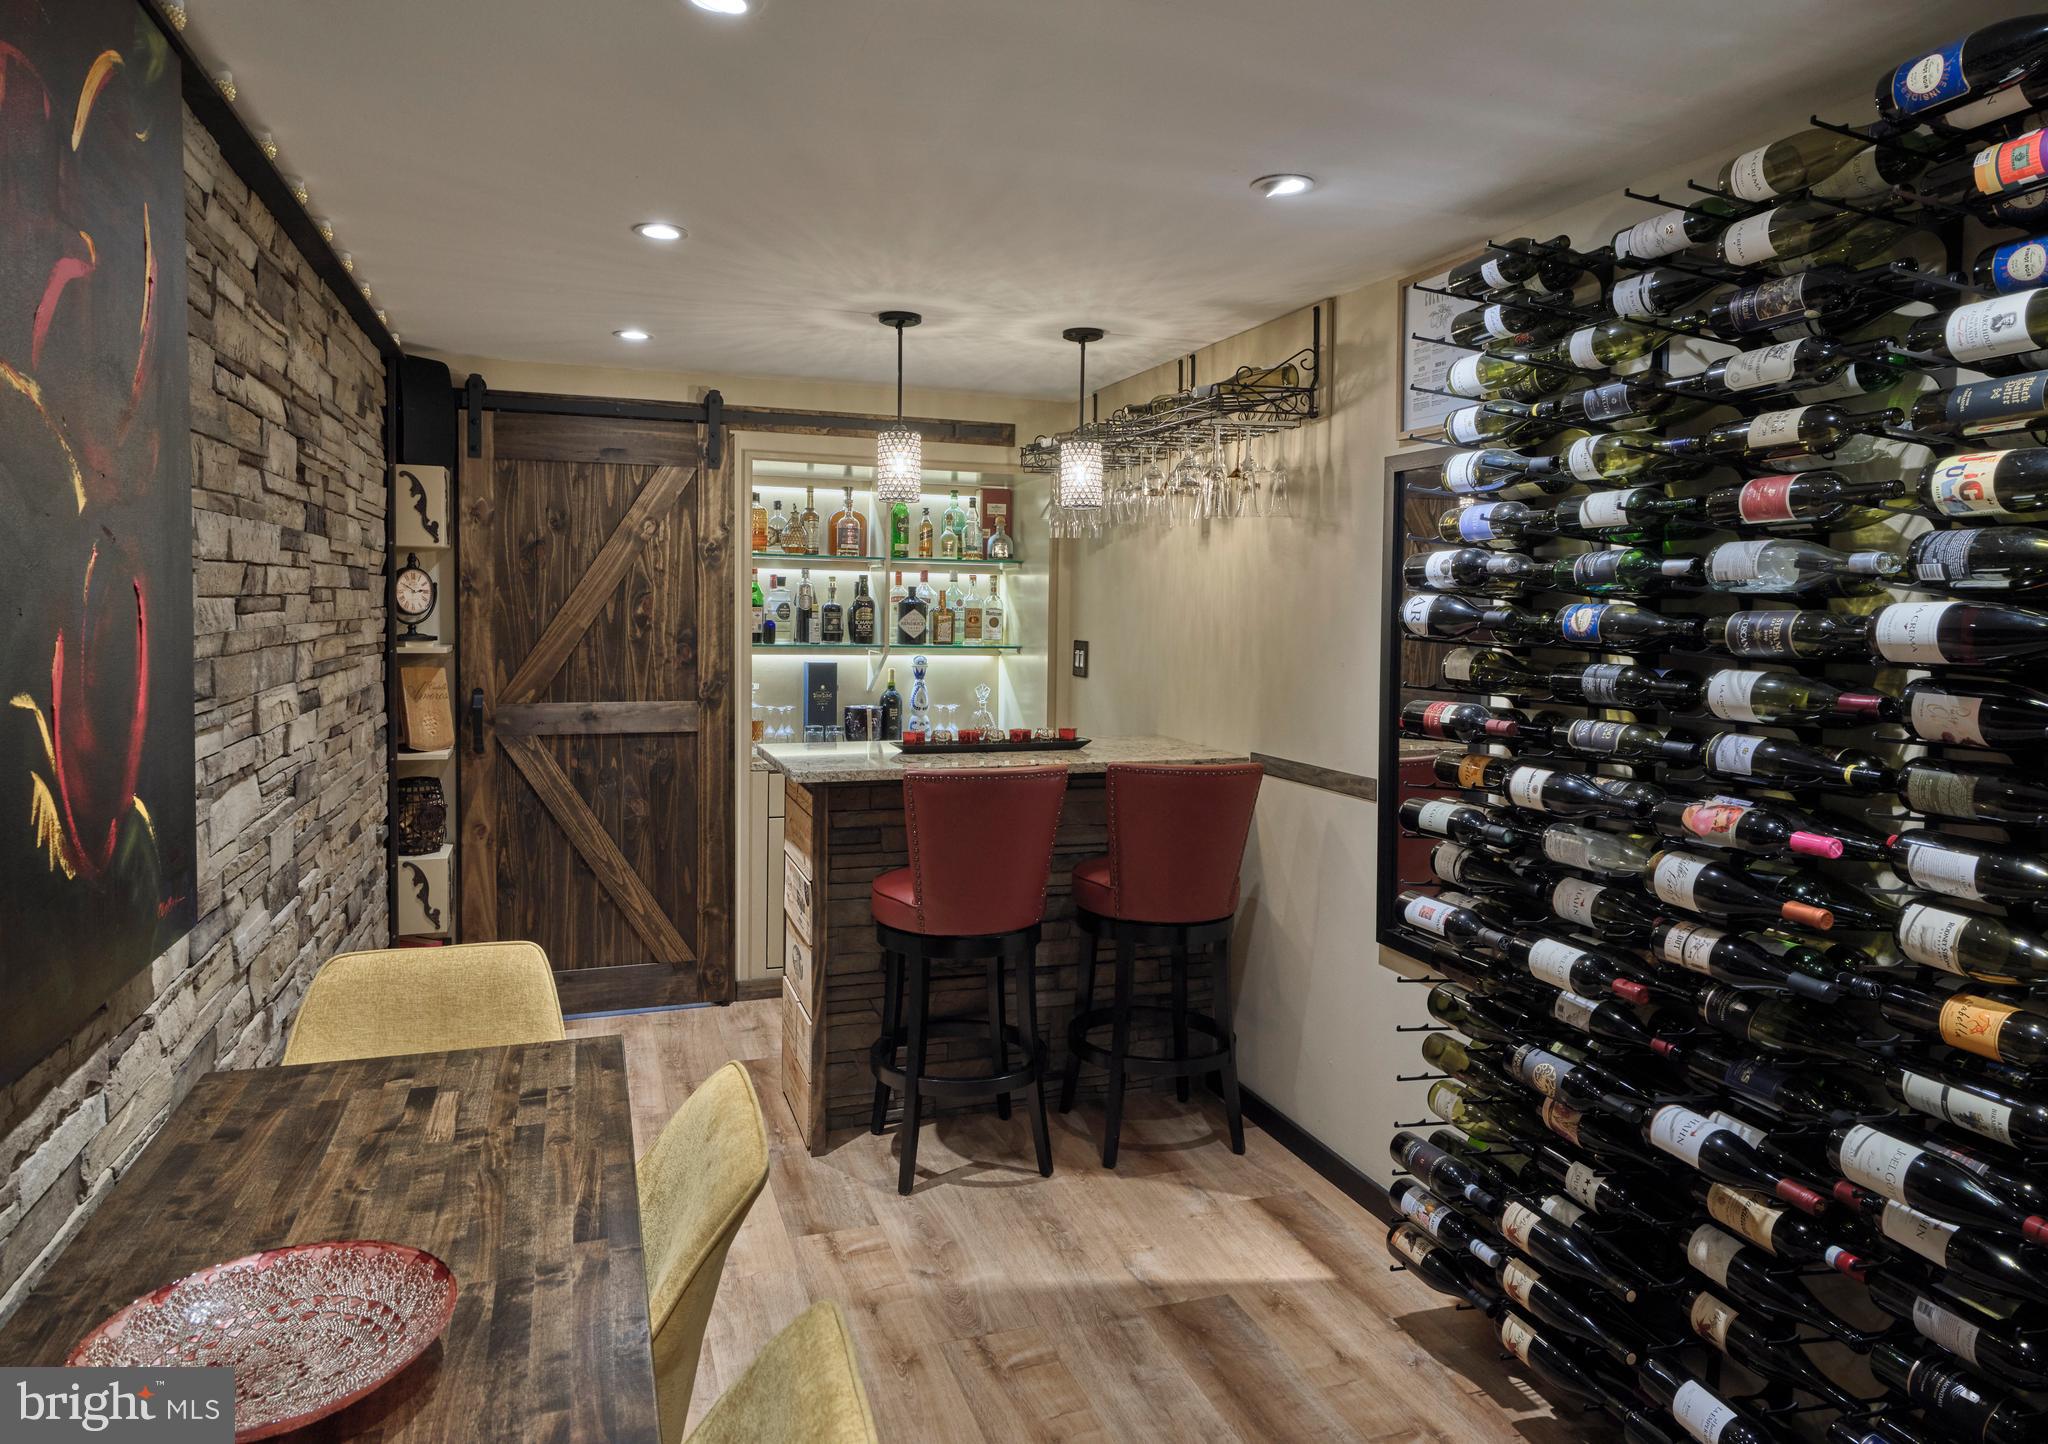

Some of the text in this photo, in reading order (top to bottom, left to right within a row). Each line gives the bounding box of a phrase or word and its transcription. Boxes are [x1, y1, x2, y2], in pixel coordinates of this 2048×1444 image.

[1751, 162, 1762, 192] CREMA
[1737, 232, 1745, 259] CREMA
[1982, 313, 1996, 351] ARCHDUKE
[1740, 618, 1751, 655] TOSCANA
[1774, 617, 1785, 652] STEFANO
[1909, 615, 1919, 652] CREMA
[1941, 921, 1956, 946] RODNEY
[1676, 1119, 1700, 1145] HAHN
